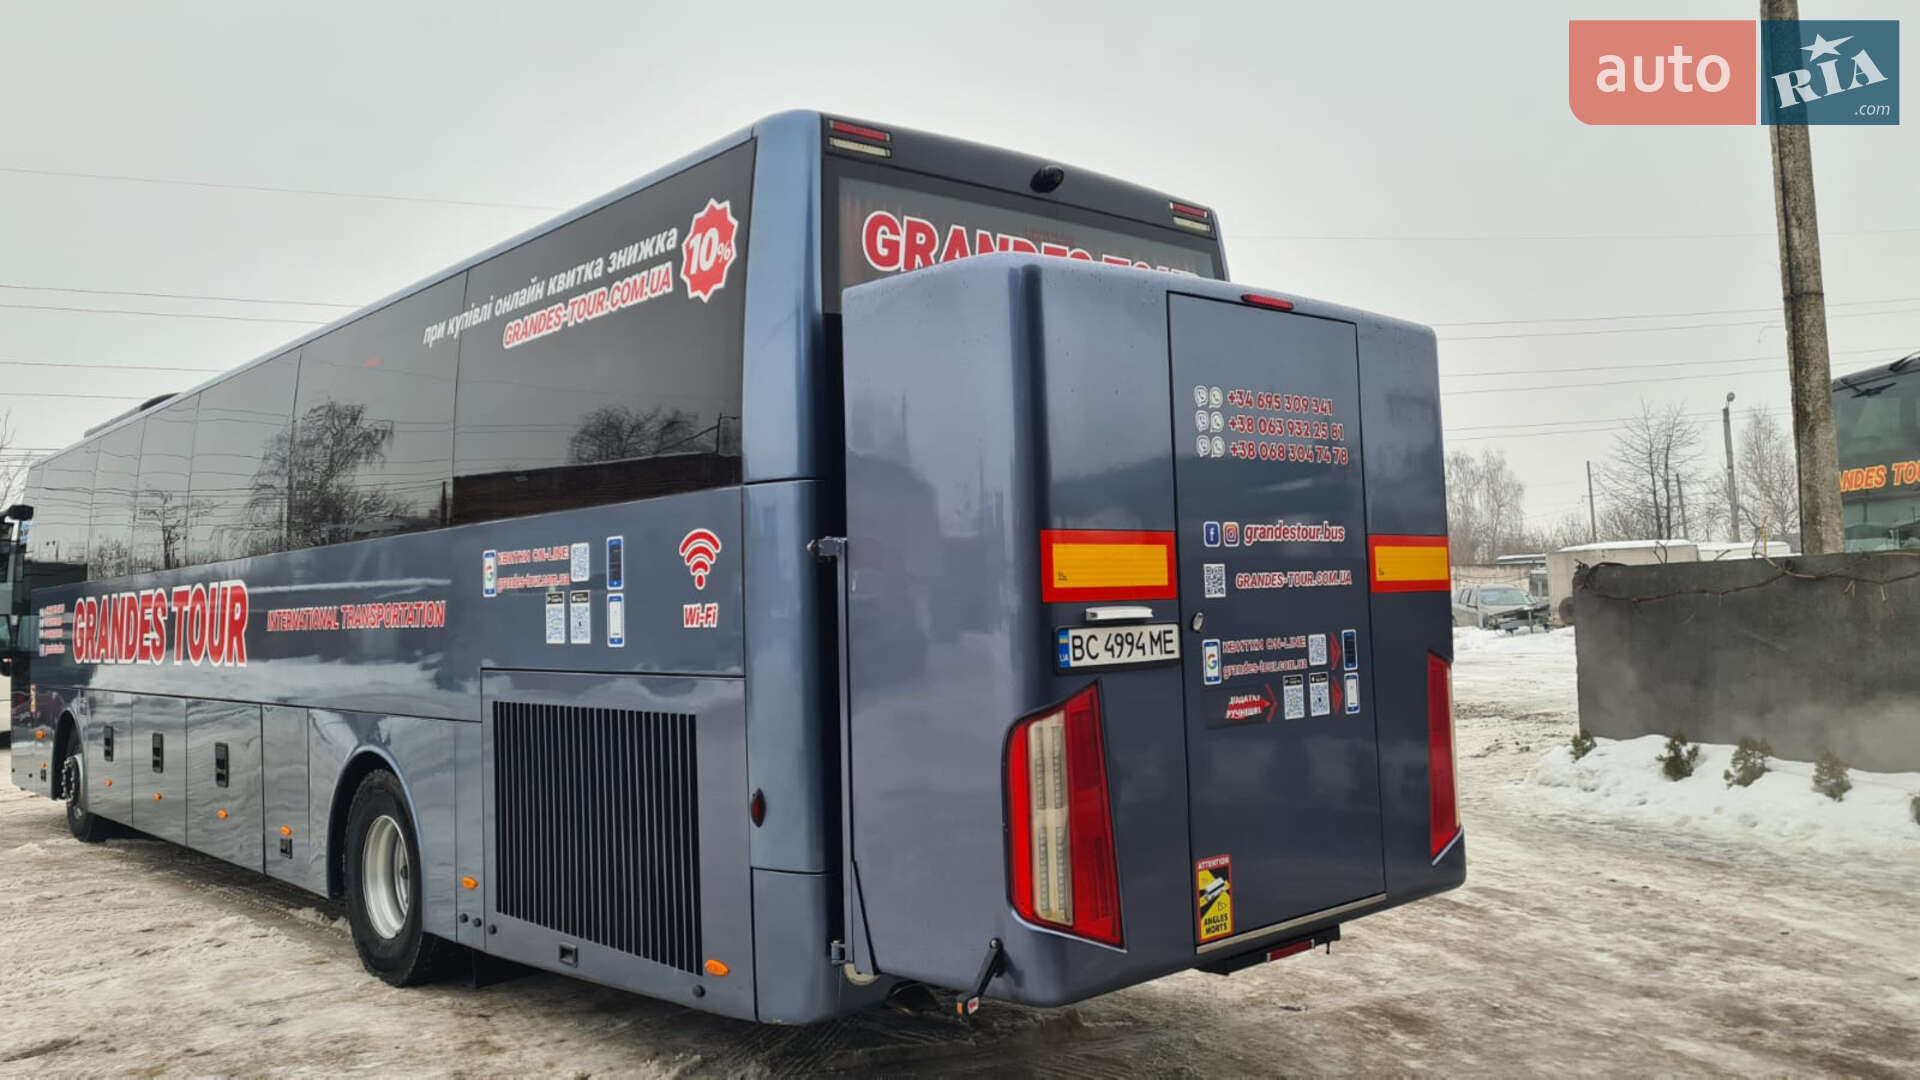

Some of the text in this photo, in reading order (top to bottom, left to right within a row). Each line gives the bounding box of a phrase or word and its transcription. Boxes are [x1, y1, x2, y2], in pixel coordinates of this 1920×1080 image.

[688, 227, 732, 276] 10%
[423, 227, 679, 349] при купівлі онлайн квитка знижка
[503, 262, 673, 350] GRANDES-TOUR.COM.UA
[1228, 389, 1333, 416] +34 695 309 341
[1228, 414, 1255, 434] +38
[1257, 416, 1284, 436] 063
[1287, 418, 1311, 439] 932
[1313, 420, 1328, 440] 25
[1229, 440, 1348, 465] +38 068 304 74 78
[1840, 460, 1920, 492] NDES TO
[1244, 520, 1345, 546] grandestour.bus
[1235, 570, 1352, 589] GRANDES-TOUR.COM.UA
[72, 579, 249, 667] GRANDES TOUR
[266, 600, 447, 632] INTERNATIONAL TRANSPORTATION
[683, 603, 719, 628] Wi-Fi
[1071, 630, 1175, 662] BC 4994 ME
[1204, 913, 1228, 926] ANGLES
